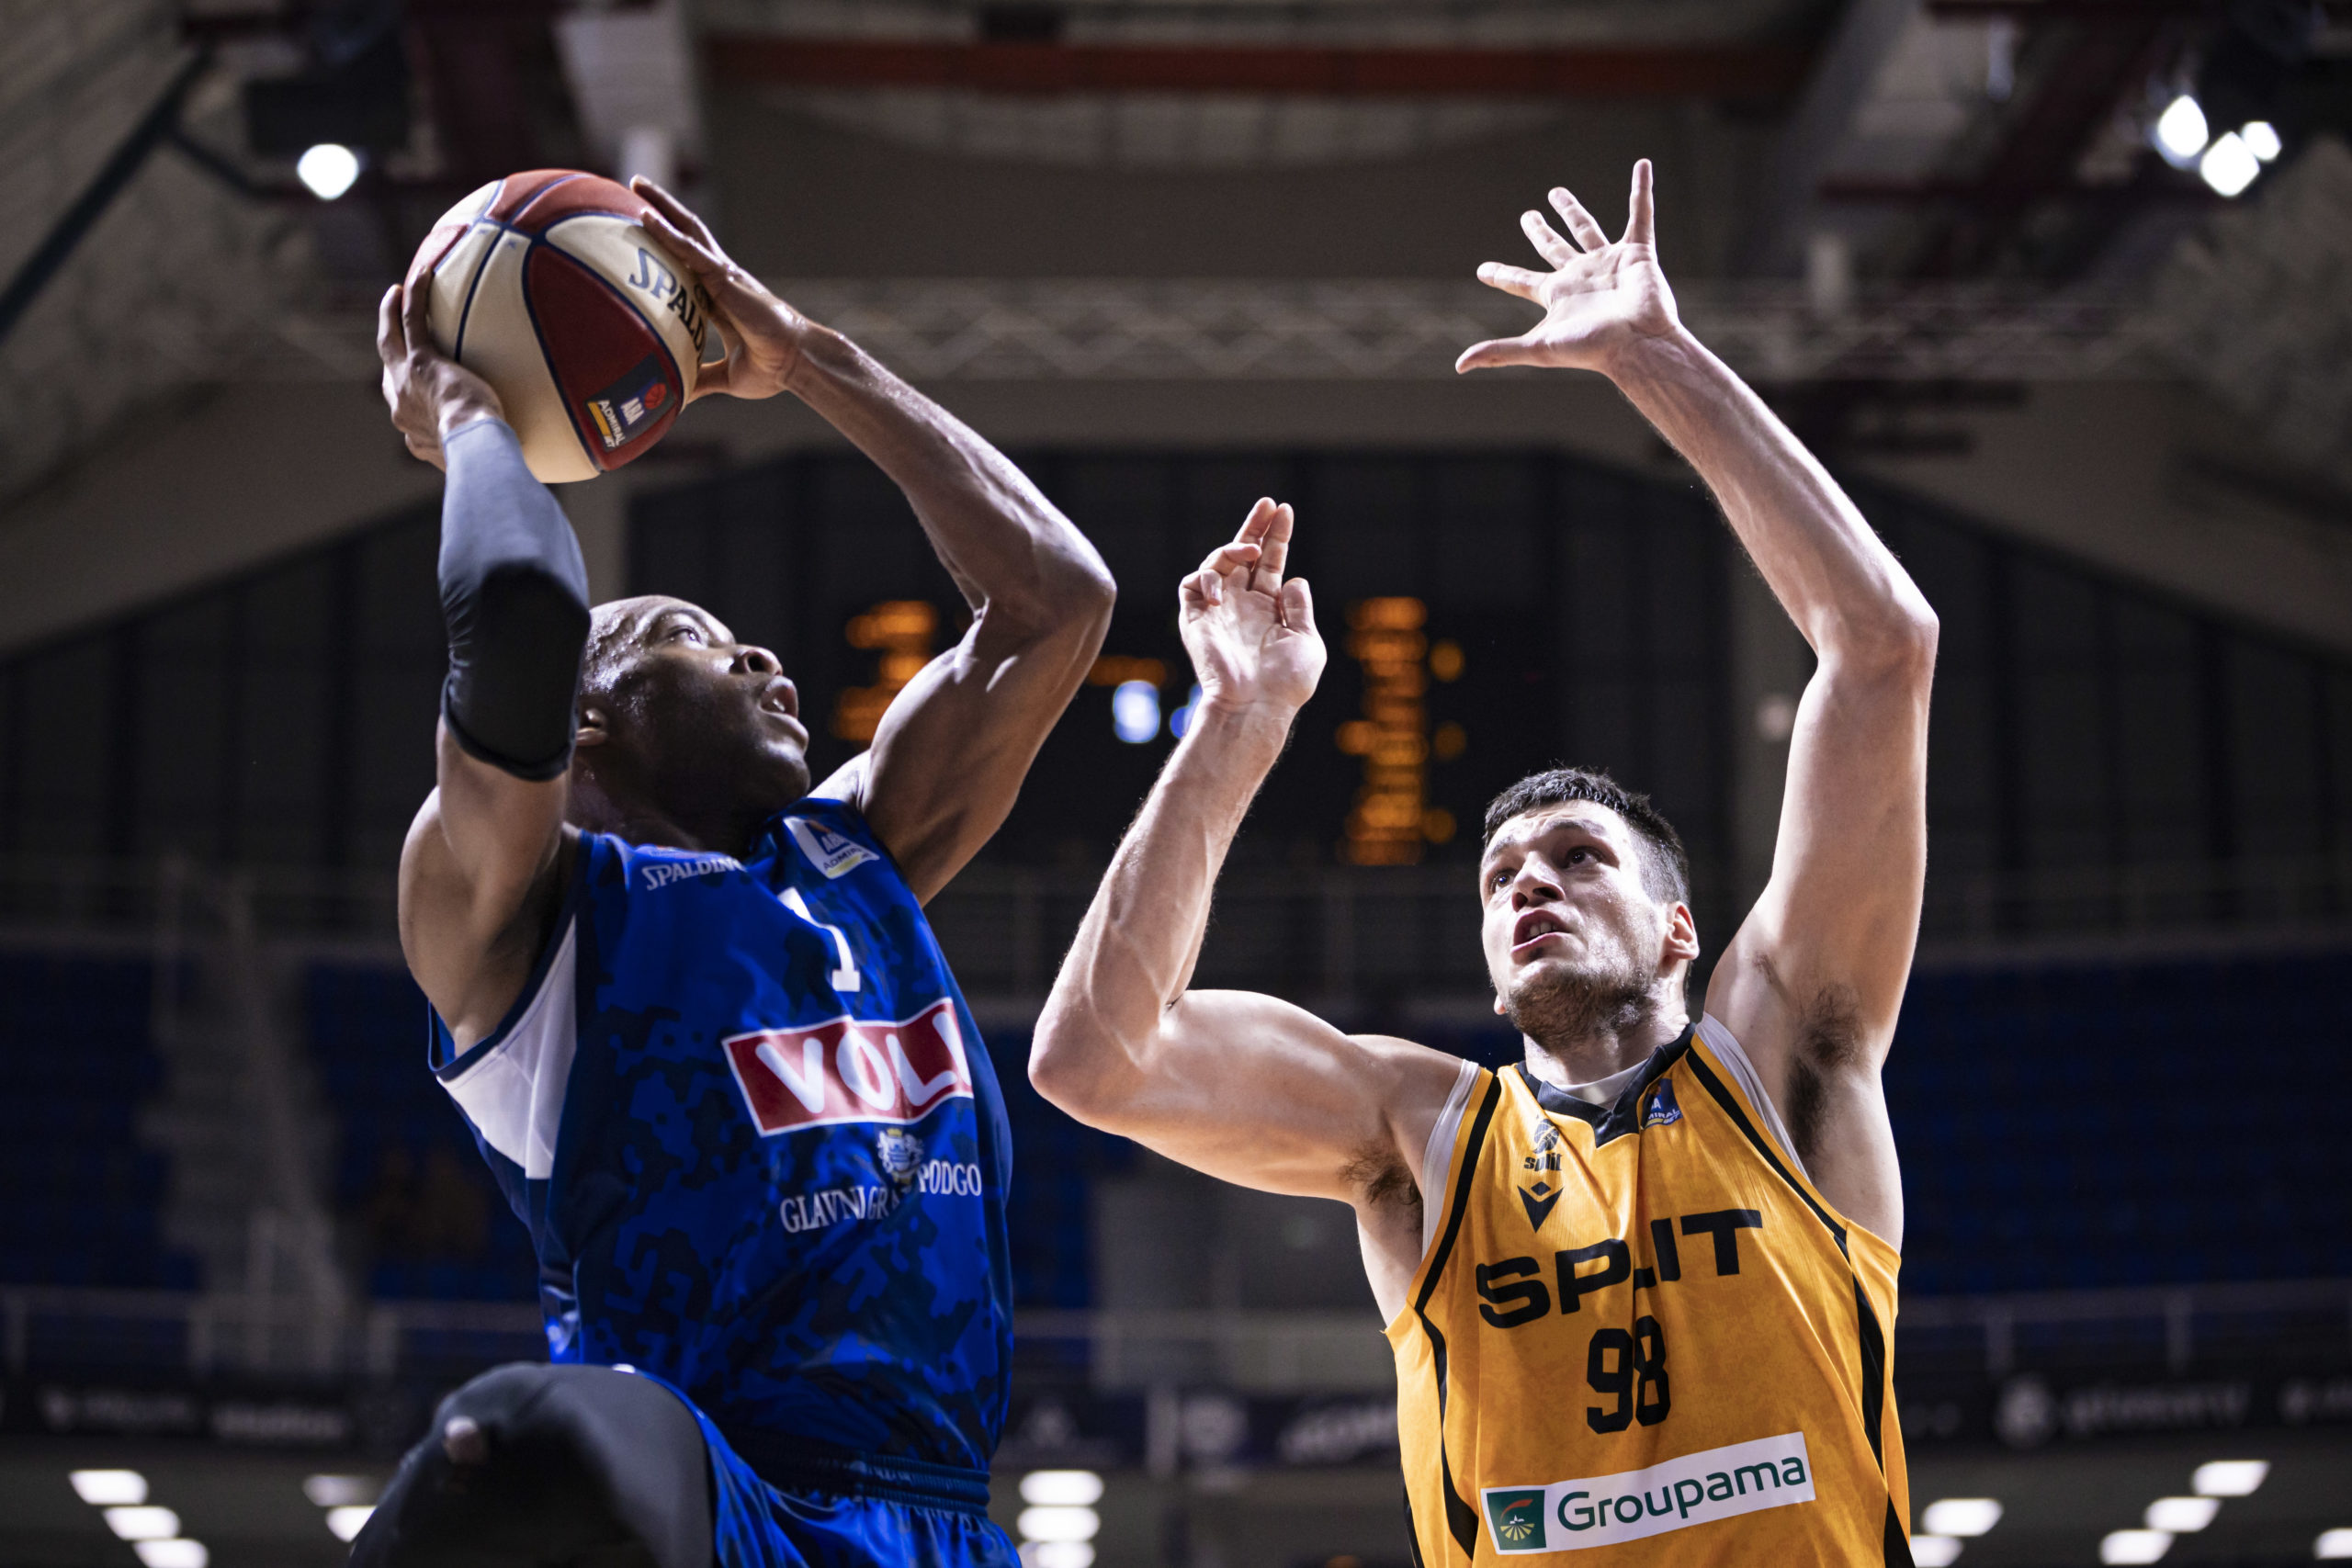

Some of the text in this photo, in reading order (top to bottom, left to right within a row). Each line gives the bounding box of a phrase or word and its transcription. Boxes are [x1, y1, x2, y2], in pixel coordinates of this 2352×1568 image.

[597, 399, 626, 446] ADMIRAL
[777, 886, 860, 992] 1
[780, 1186, 867, 1234] GLAVNI
[1587, 1314, 1671, 1435] 98
[1556, 1456, 1807, 1532] Groupama
